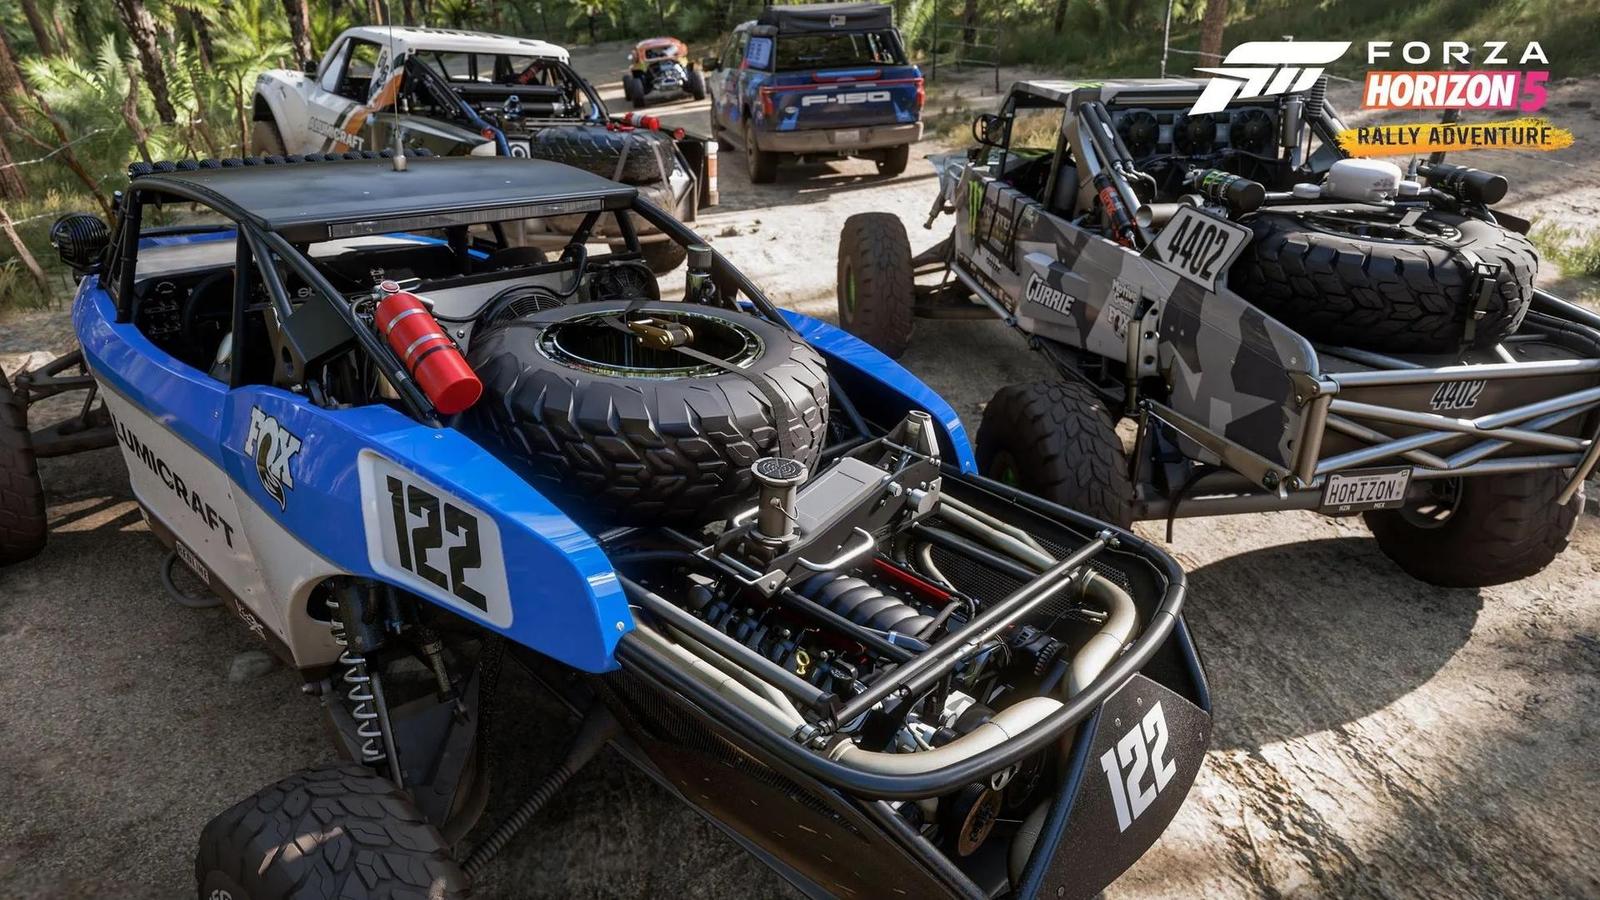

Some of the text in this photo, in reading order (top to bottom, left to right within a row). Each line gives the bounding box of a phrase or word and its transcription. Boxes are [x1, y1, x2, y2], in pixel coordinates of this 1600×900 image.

[801, 91, 891, 107] F-150
[1167, 214, 1230, 282] 4402
[1025, 271, 1076, 316] CURRIE
[1429, 380, 1488, 411] 4402
[244, 404, 303, 513] FOX
[1328, 479, 1397, 504] HORIZON
[386, 474, 489, 614] 122
[1100, 700, 1177, 833] 122
